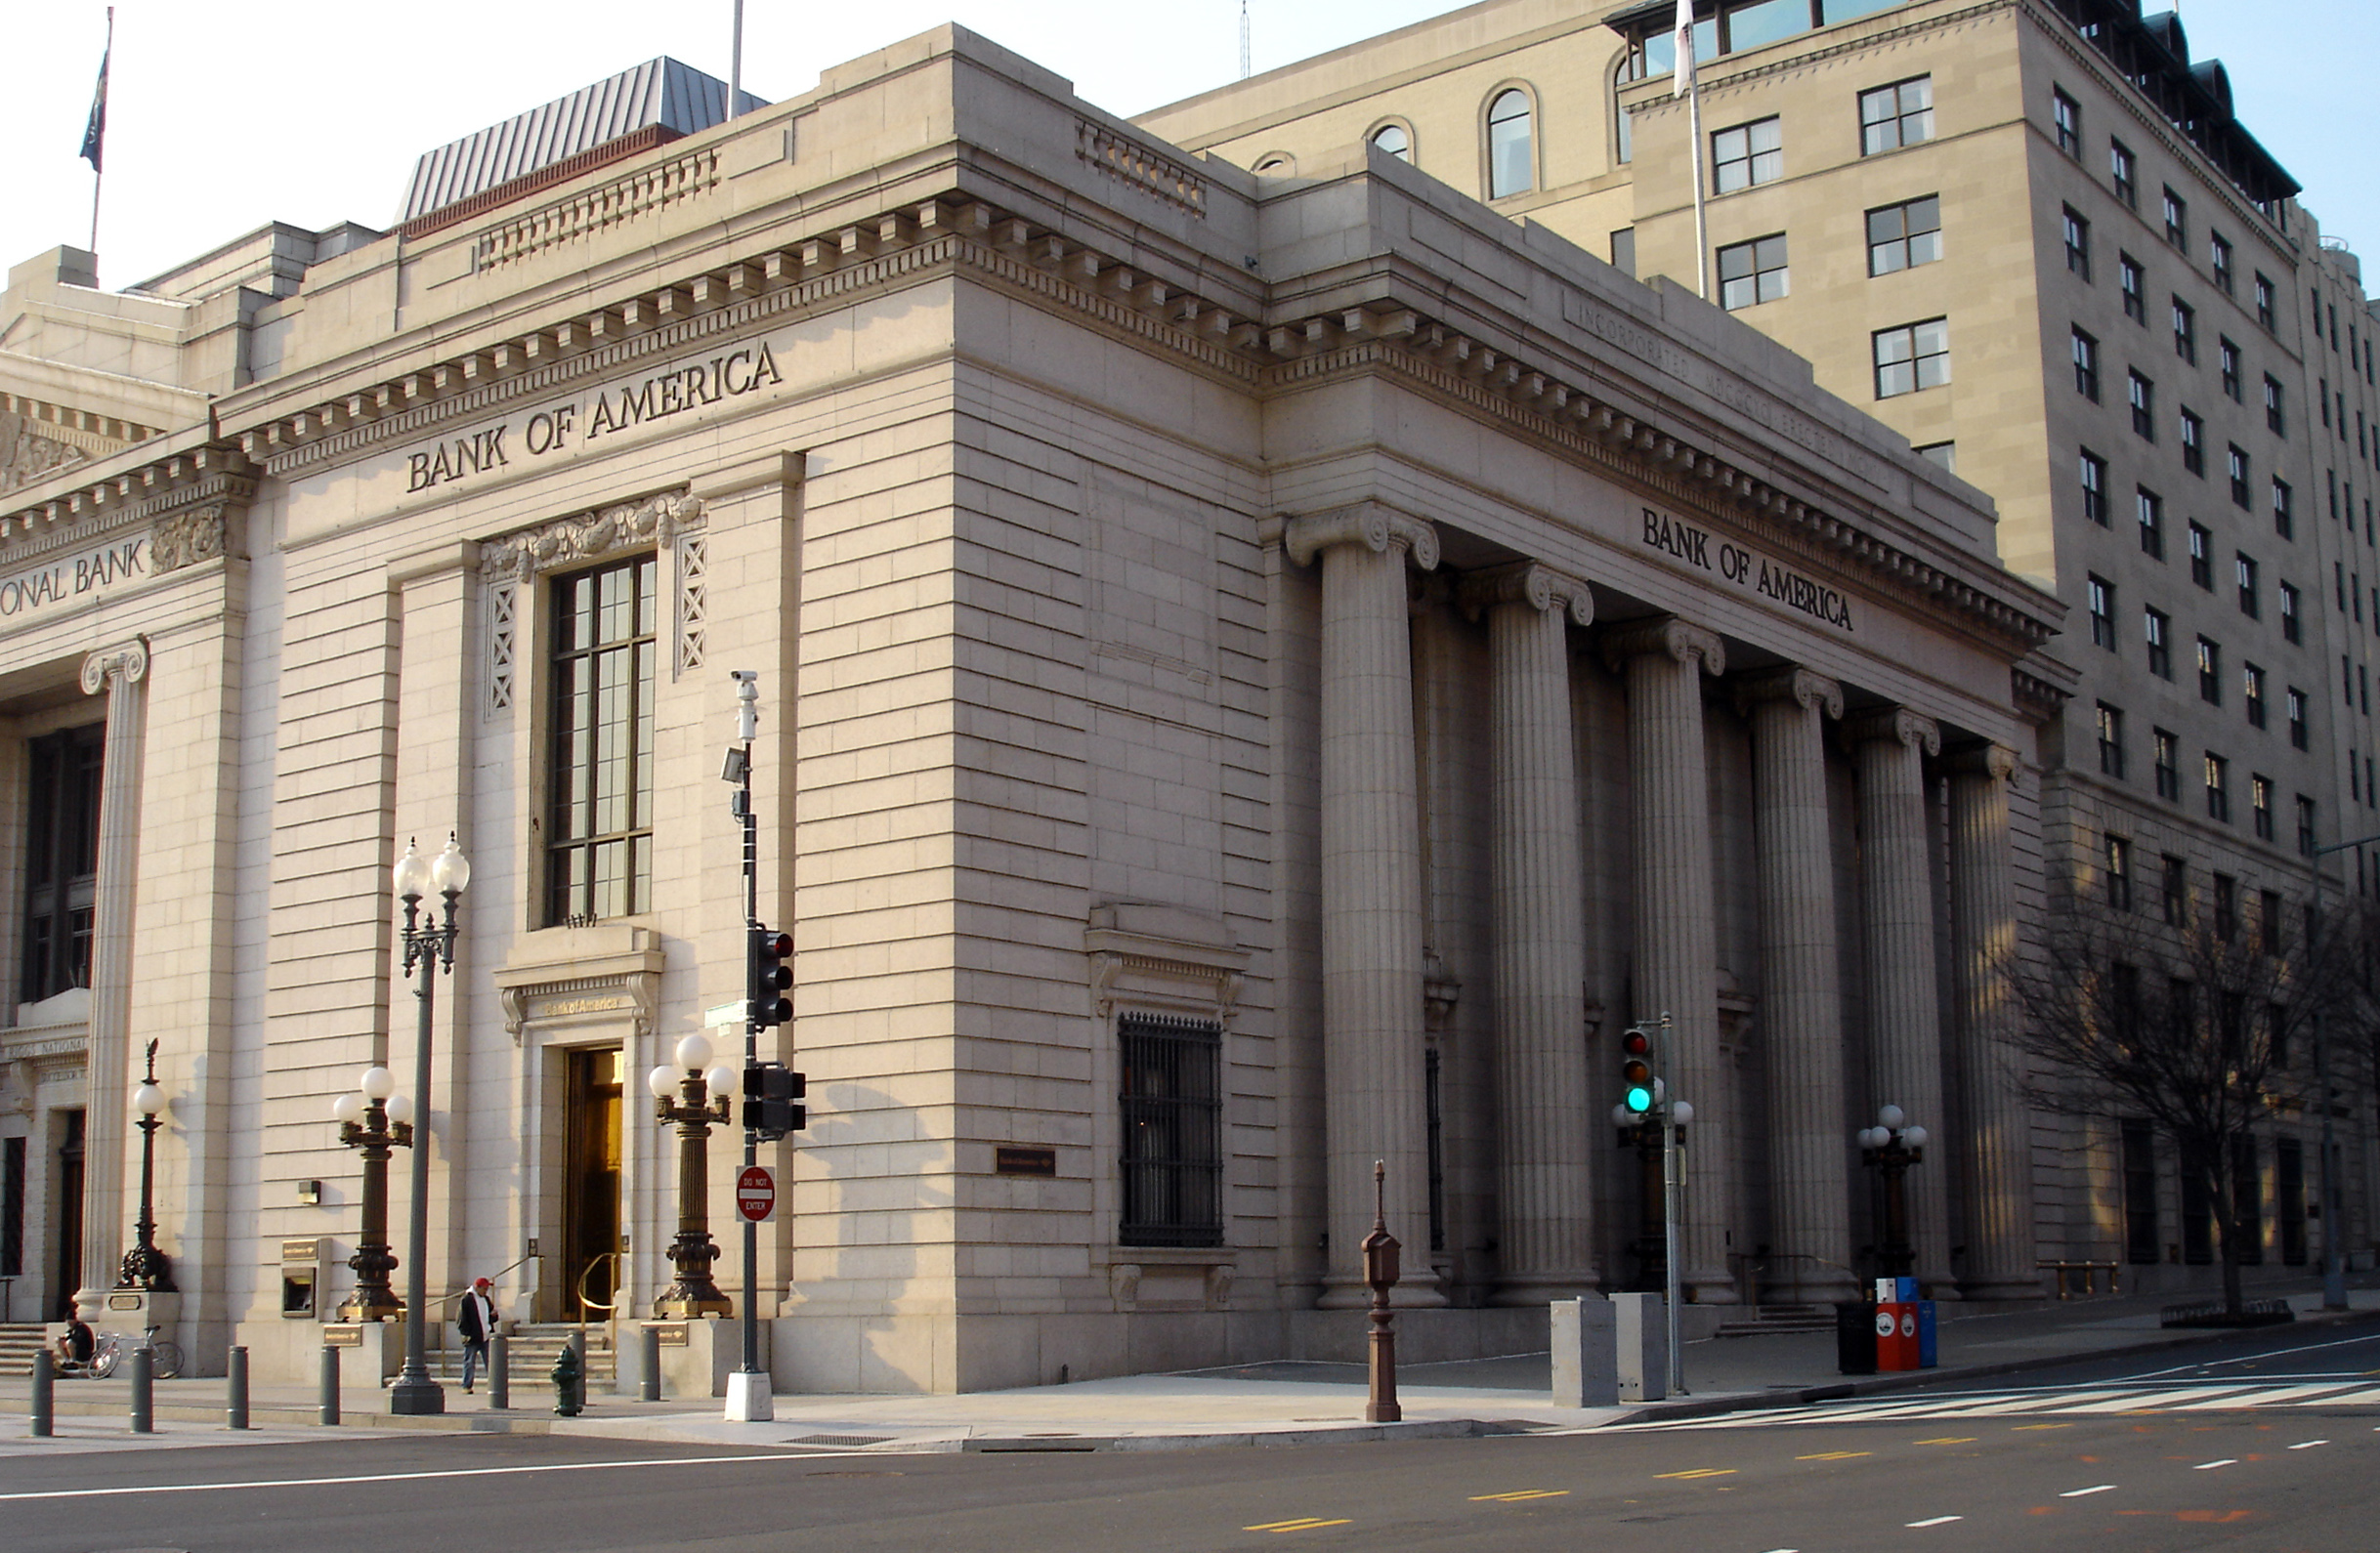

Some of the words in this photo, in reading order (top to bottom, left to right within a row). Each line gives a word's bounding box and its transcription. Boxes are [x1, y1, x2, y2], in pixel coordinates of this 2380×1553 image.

[1579, 304, 1689, 378] INCORPORATED
[406, 425, 509, 493] BANK
[526, 403, 574, 455] OF
[587, 341, 783, 440] AMERICA
[0, 567, 66, 615] ONAL
[75, 539, 146, 595] BANK
[1642, 507, 1711, 570] BANK
[1720, 543, 1750, 584] OF
[1757, 559, 1853, 632] AMERICA
[744, 1178, 752, 1187] DO
[755, 1178, 767, 1187] NOT
[745, 1201, 766, 1210] ENTER
